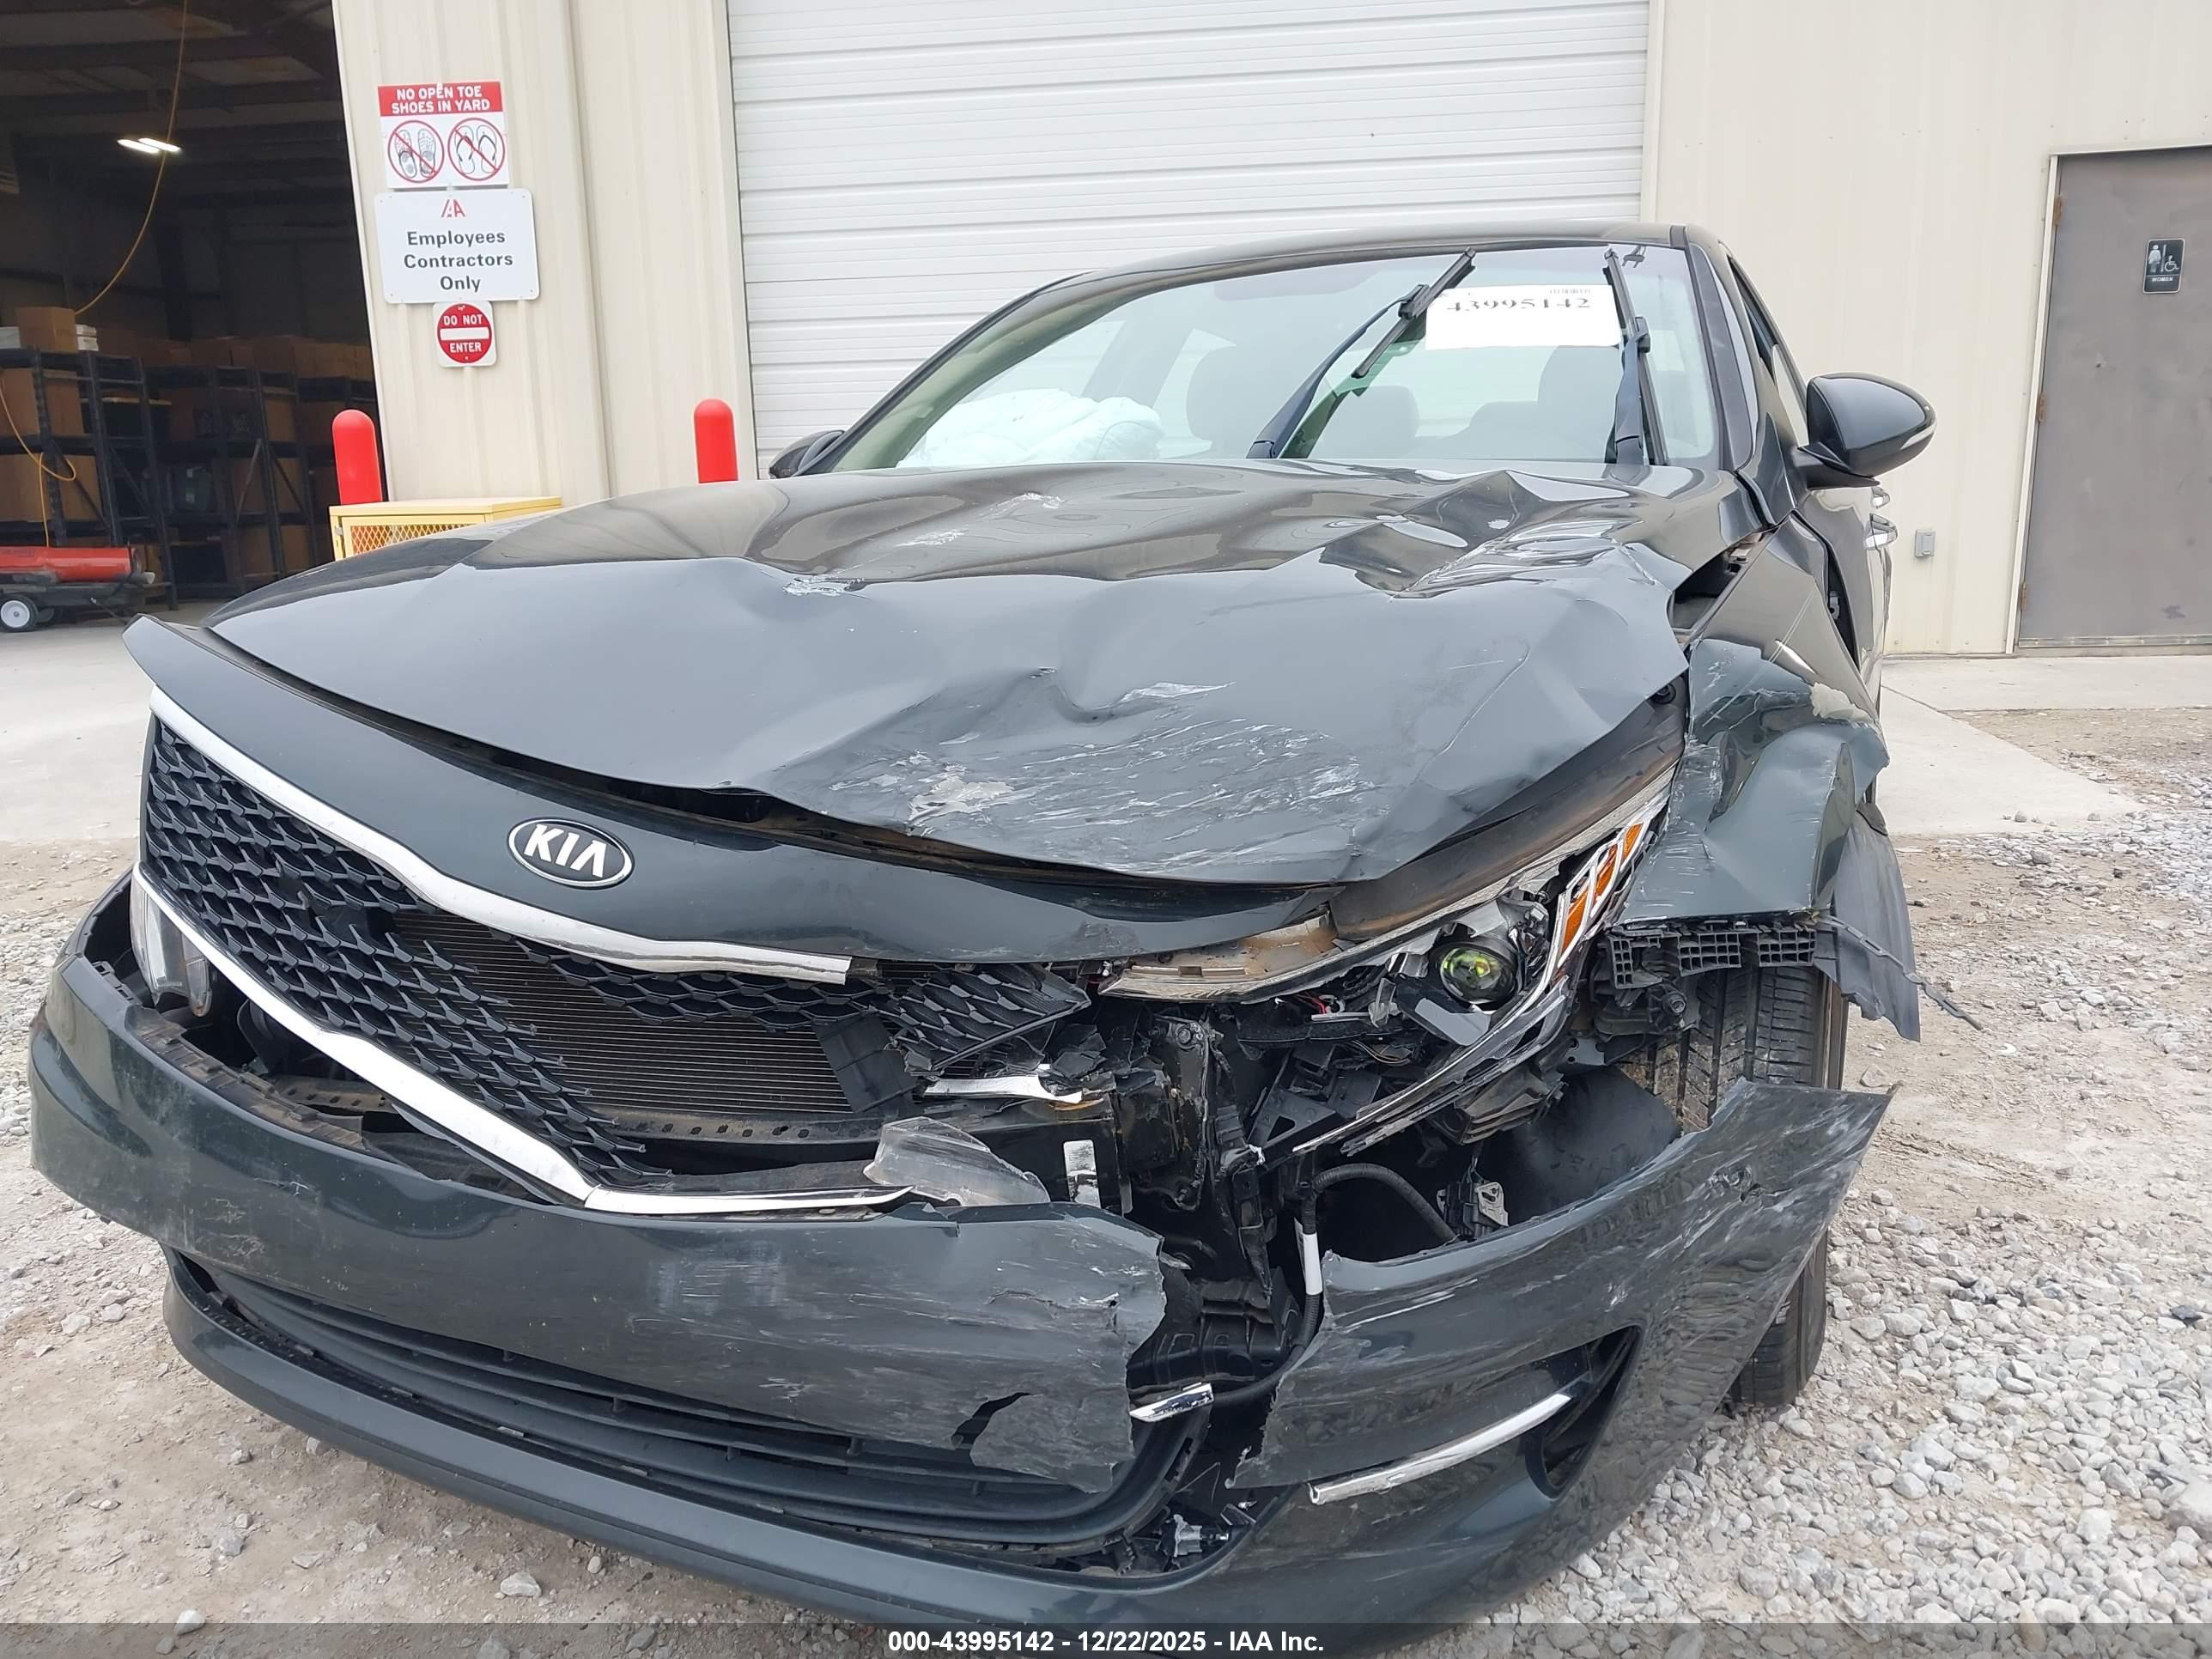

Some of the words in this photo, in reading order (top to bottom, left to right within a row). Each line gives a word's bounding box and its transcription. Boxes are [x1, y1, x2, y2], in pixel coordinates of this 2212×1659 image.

[397, 88, 415, 100] NO
[419, 87, 453, 100] OPEN
[459, 85, 482, 97] TOE
[392, 101, 434, 114] SHOES
[438, 100, 452, 112] IN
[455, 98, 490, 111] YARD
[407, 230, 506, 248] Employees
[404, 253, 514, 269] Contractors
[440, 276, 481, 292] Only
[1446, 298, 1591, 312] 43995142
[443, 315, 458, 325] DO
[463, 314, 483, 325] NOT
[450, 342, 482, 353] ENTER
[524, 823, 607, 878] KIA
